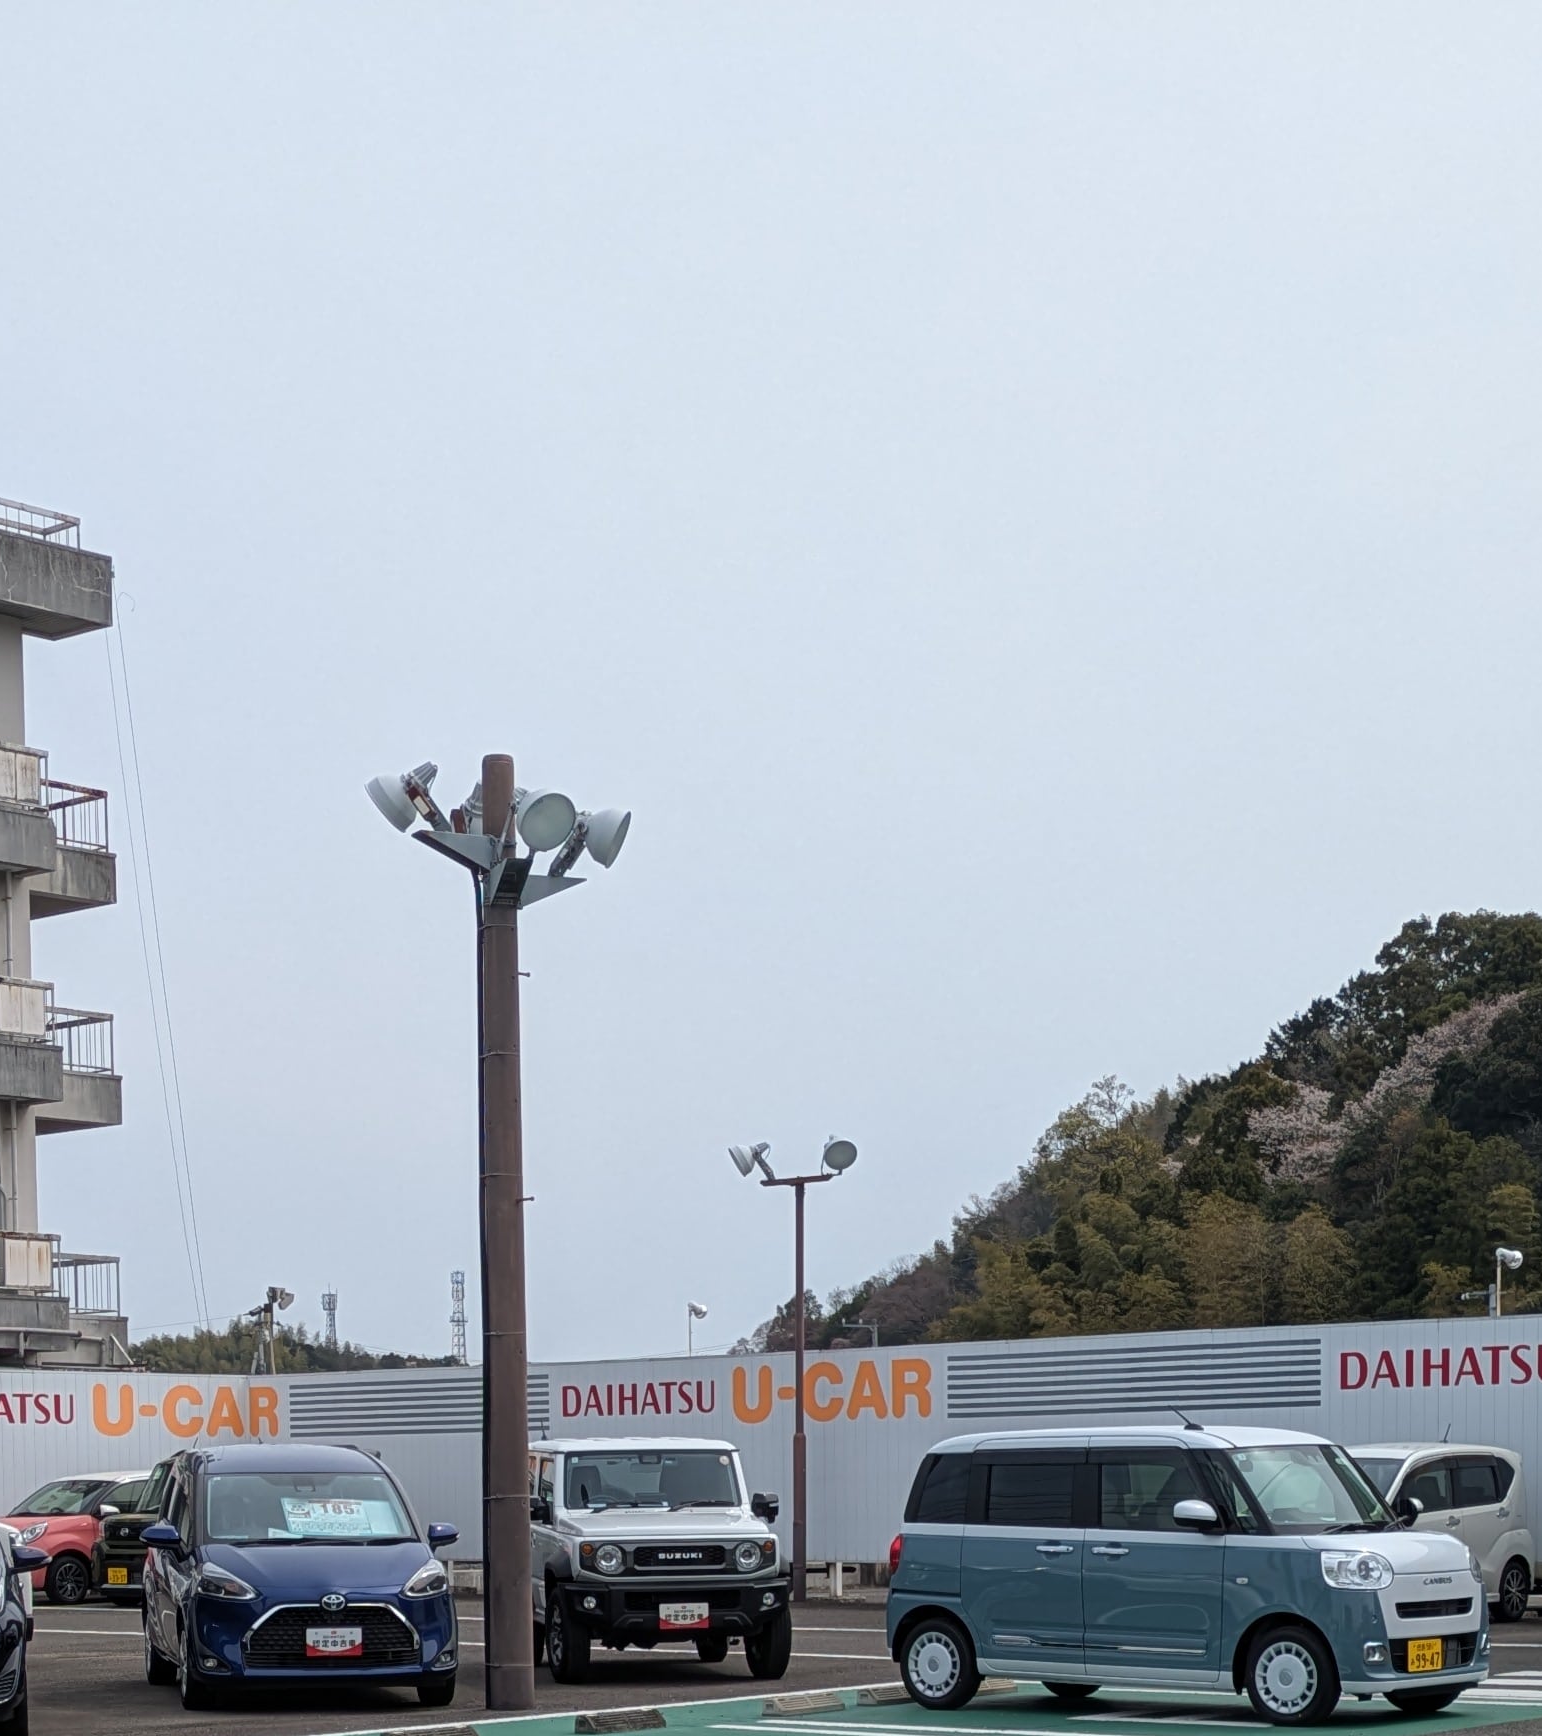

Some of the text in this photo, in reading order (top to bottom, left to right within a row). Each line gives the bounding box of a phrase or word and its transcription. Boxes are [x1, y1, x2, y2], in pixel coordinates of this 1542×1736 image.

[562, 1359, 932, 1424] DAIHATSU U-CAR
[92, 1383, 279, 1438] U-CAR
[321, 1503, 355, 1515] 185
[1423, 1576, 1453, 1585] CANBUS
[1415, 1652, 1440, 1669] 99-47
